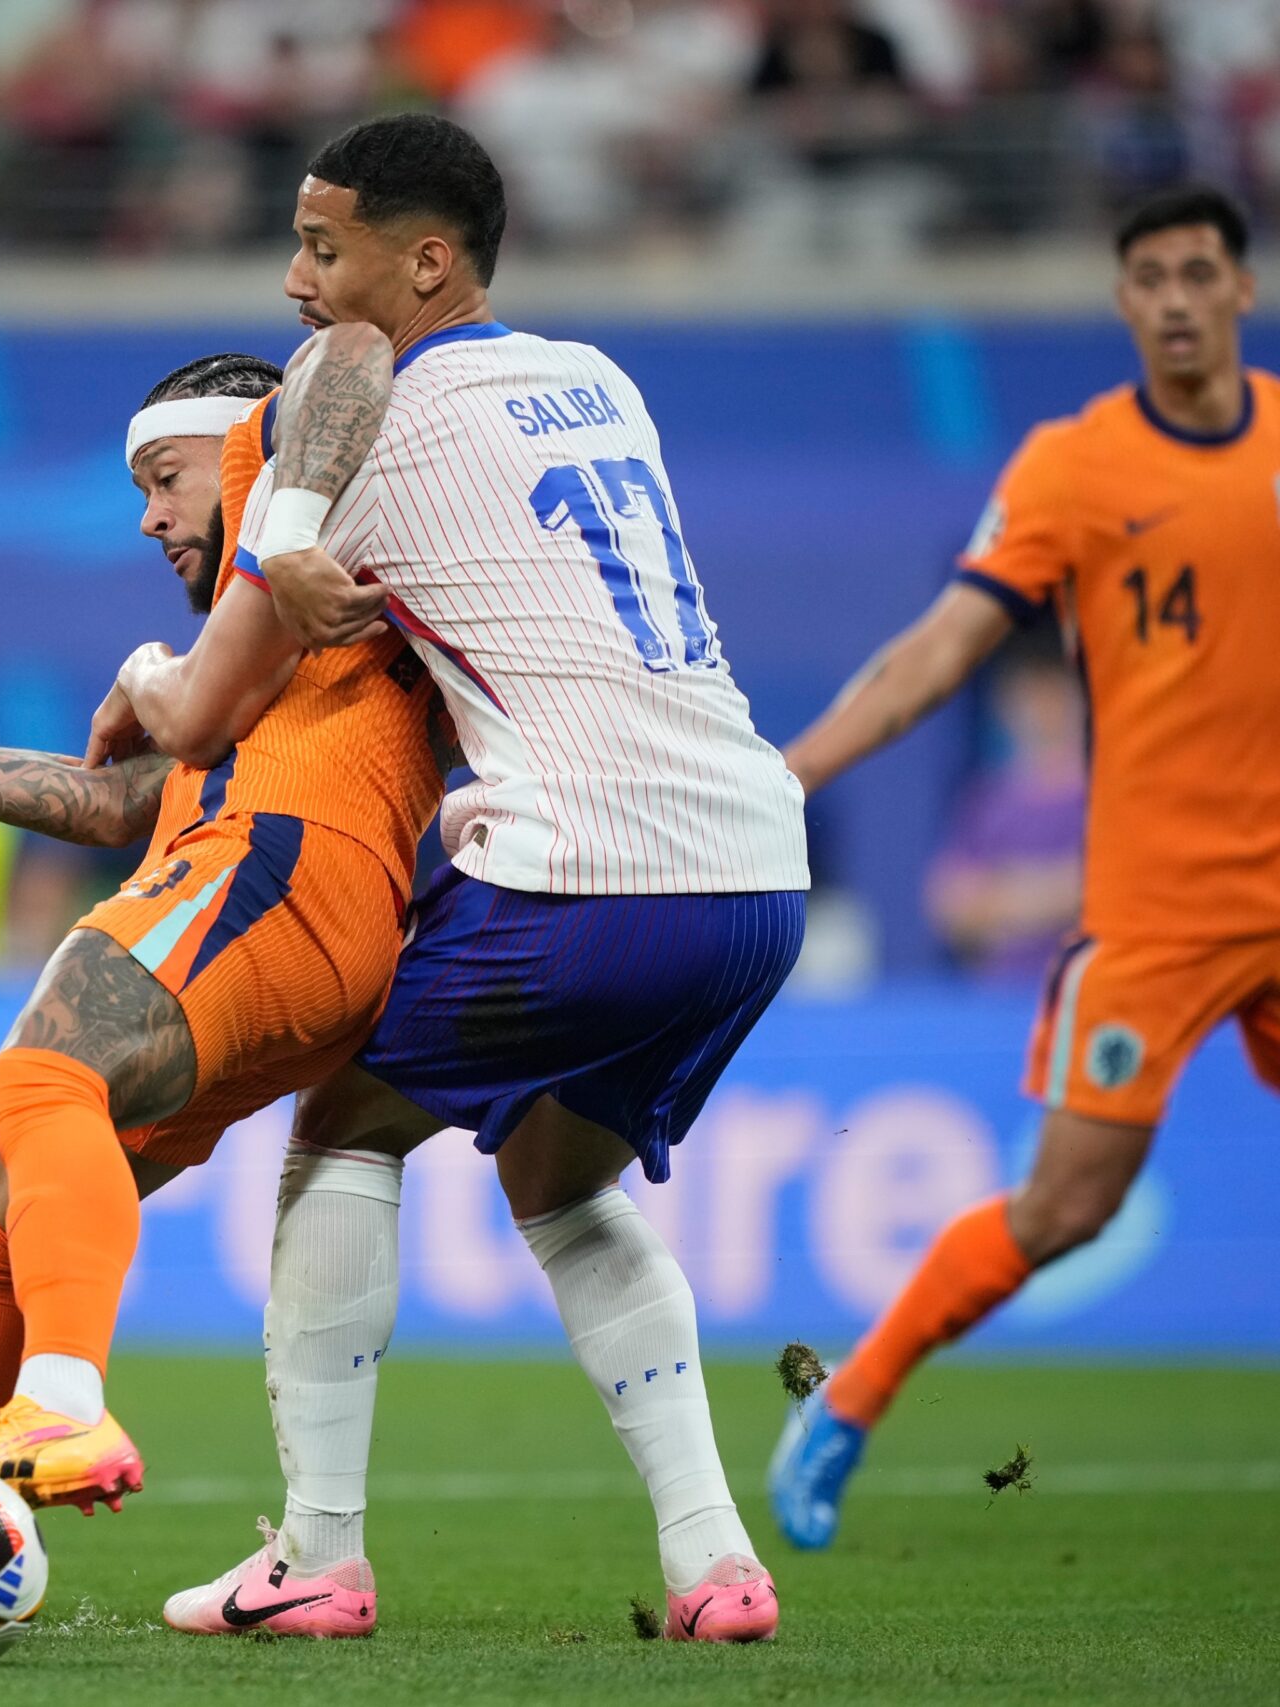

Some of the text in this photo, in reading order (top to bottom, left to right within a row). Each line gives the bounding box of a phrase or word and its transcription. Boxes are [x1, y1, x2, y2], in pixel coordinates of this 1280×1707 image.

[505, 384, 626, 437] SALIBA
[528, 456, 718, 674] 17
[1123, 563, 1202, 646] 14
